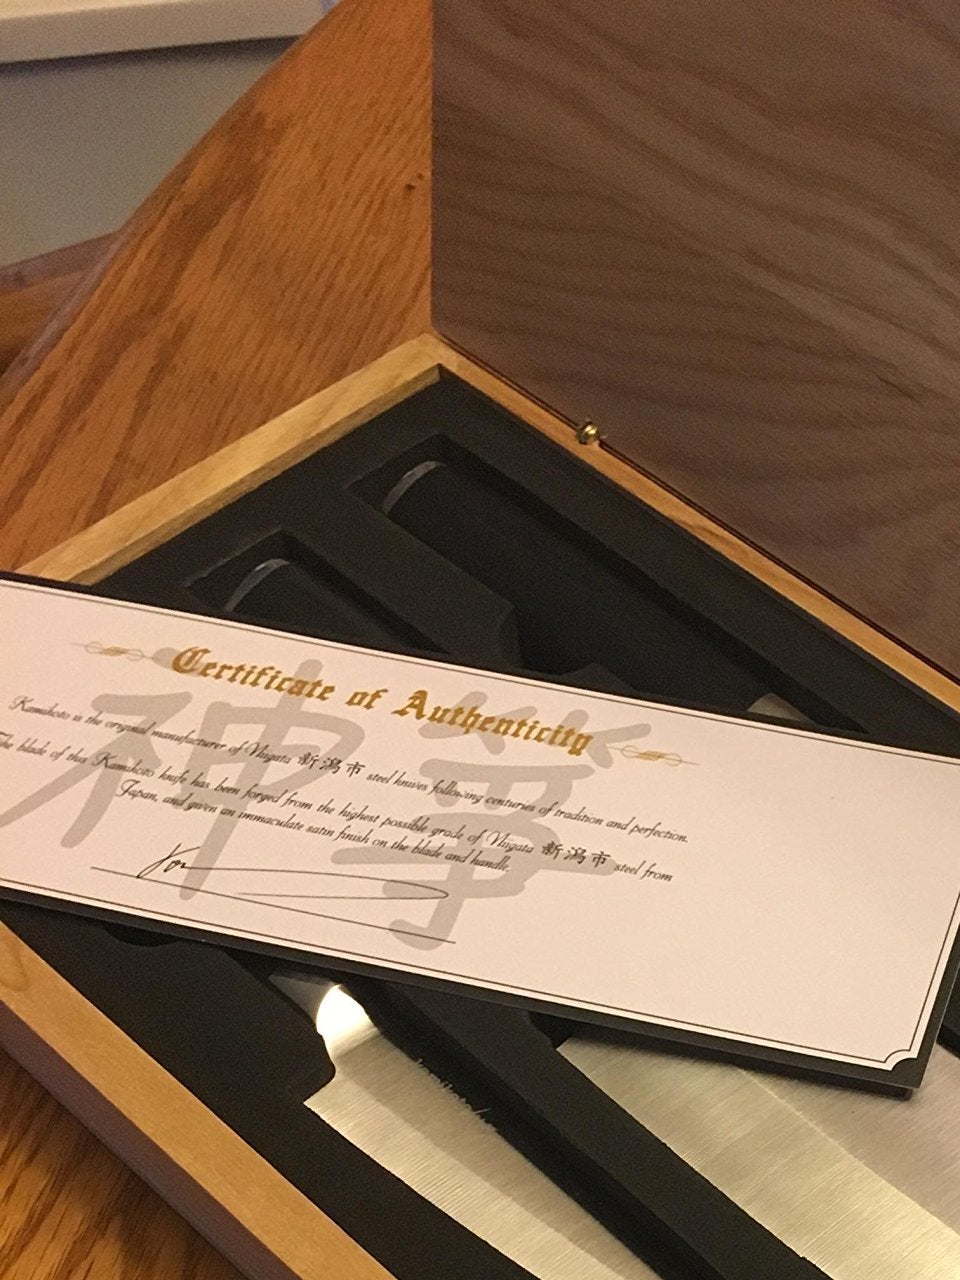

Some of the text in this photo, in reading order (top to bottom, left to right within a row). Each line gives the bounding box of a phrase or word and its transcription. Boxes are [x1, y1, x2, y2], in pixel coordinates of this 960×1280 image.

[172, 646, 594, 756] Certificate of Authenticity
[16, 738, 47, 756] blade
[49, 745, 71, 762] of
[158, 766, 187, 785] knife
[190, 772, 211, 789] has
[214, 777, 240, 795] been
[240, 783, 289, 805] forged
[280, 792, 313, 808] from
[316, 798, 335, 815] the
[338, 802, 380, 822] highest
[379, 815, 428, 833] possible
[428, 825, 464, 839] grade
[467, 829, 488, 846] of
[486, 831, 535, 854] Niigata
[613, 860, 646, 876] steel
[640, 863, 673, 882] from
[85, 711, 103, 726] the
[105, 721, 156, 735] original
[151, 729, 226, 750] manufacturer
[228, 740, 249, 756] of
[366, 770, 398, 785] steel
[393, 772, 428, 792] knives
[428, 779, 484, 805] following
[485, 796, 536, 813] centuries
[538, 801, 559, 818] of
[554, 807, 604, 826] tradition
[606, 816, 636, 831] and
[628, 822, 688, 843] perfection.
[115, 779, 511, 873] Japan, and given an immaculate satin finish on the blade and handle.
